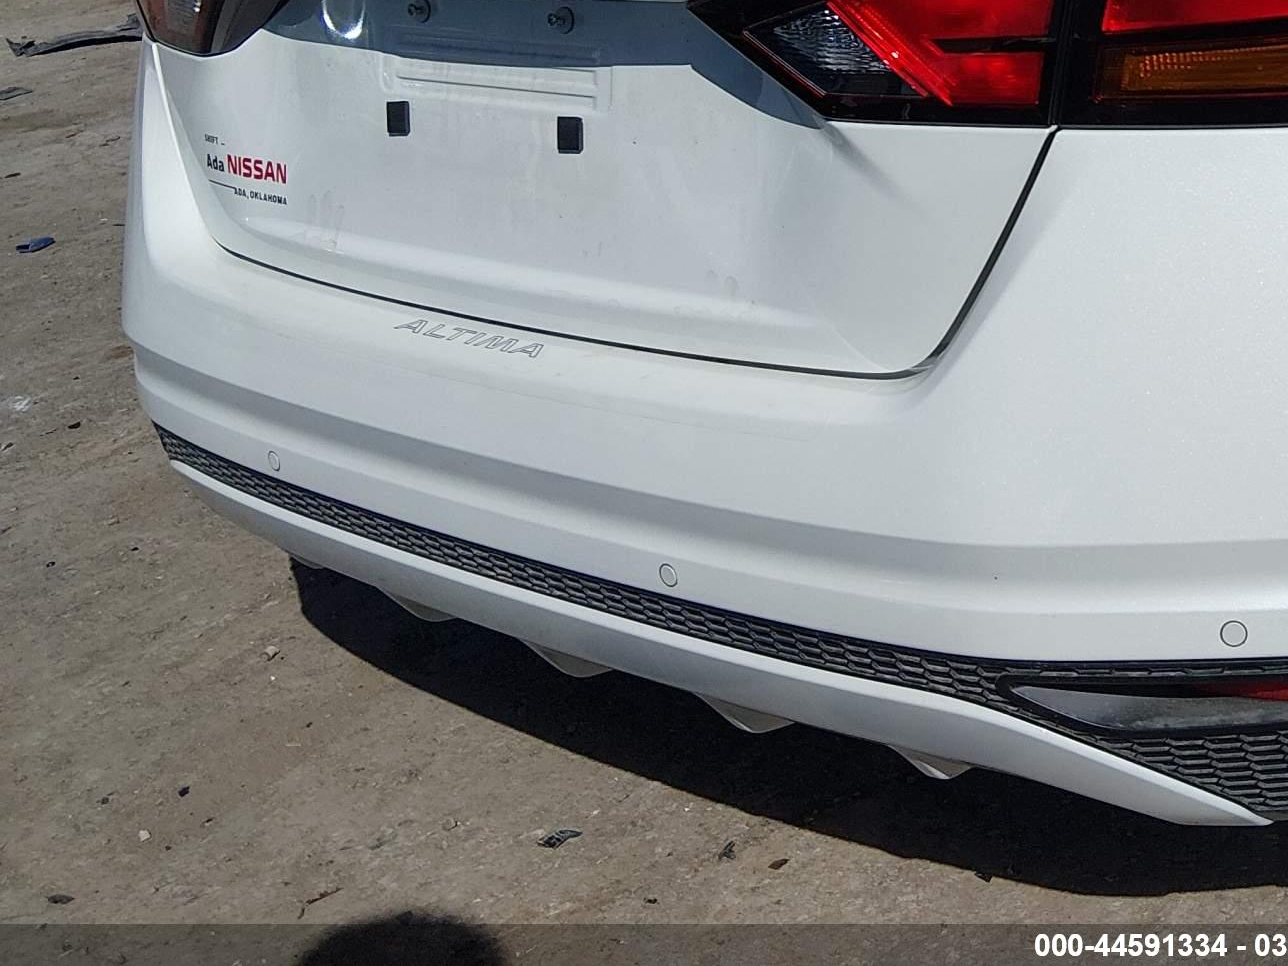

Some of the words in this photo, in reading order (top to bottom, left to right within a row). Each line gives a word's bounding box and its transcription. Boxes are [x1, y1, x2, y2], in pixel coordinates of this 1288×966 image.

[206, 153, 225, 173] Ada
[226, 154, 287, 185] NISSAN
[249, 190, 287, 206] OKLAHOMA
[393, 319, 545, 359] ALTIMA
